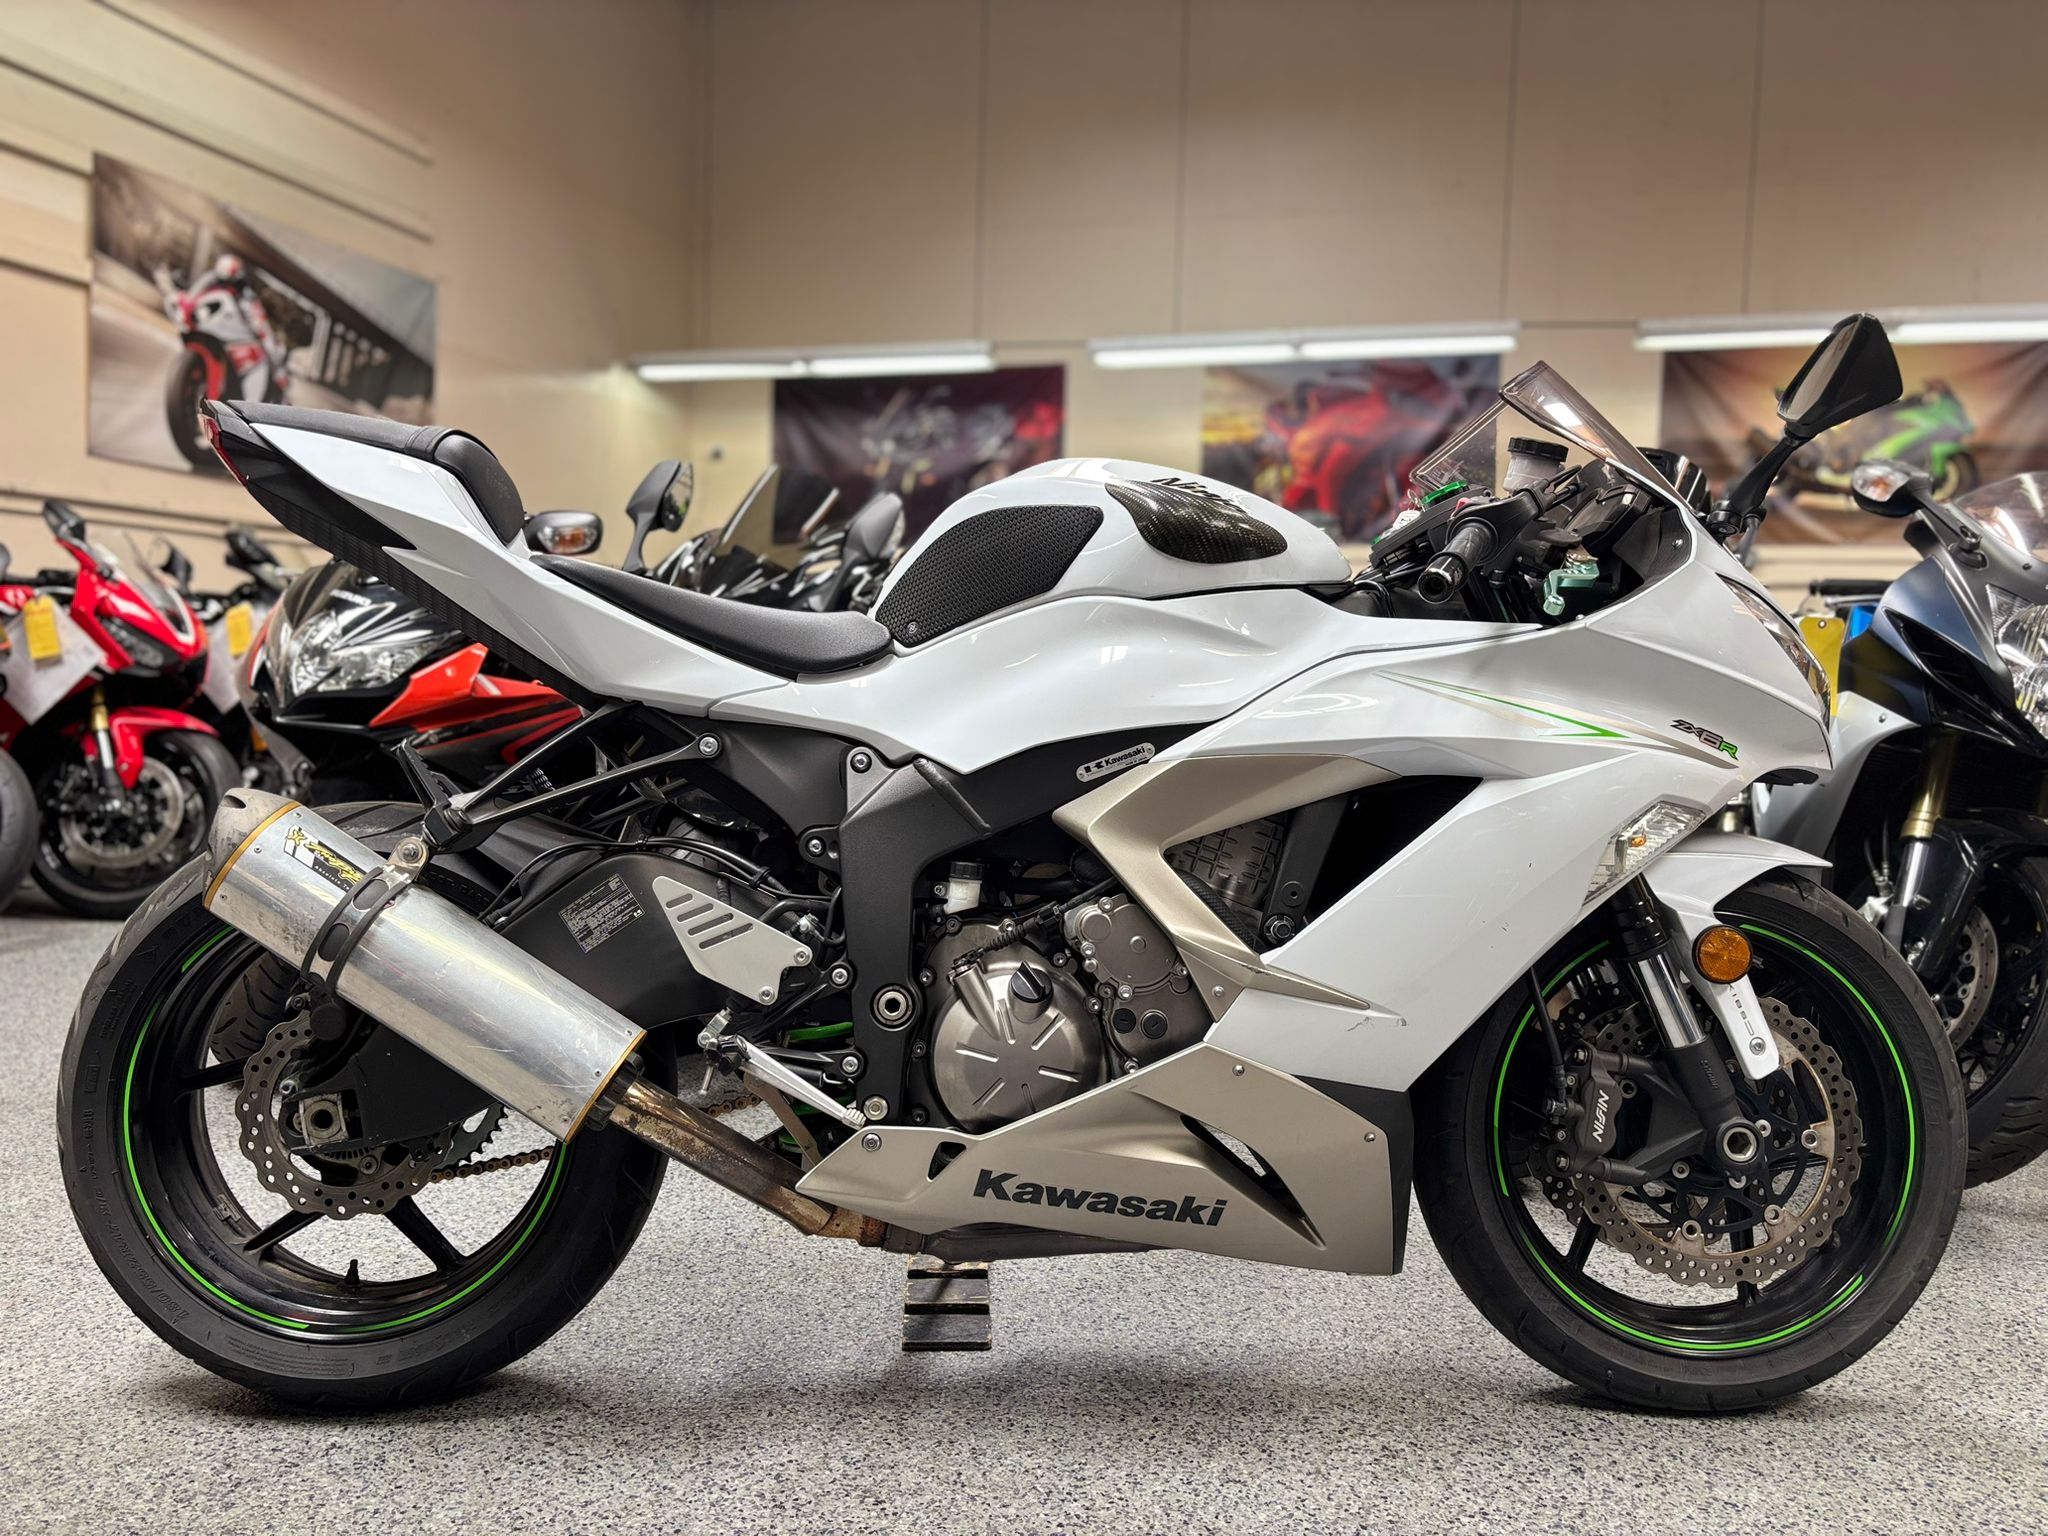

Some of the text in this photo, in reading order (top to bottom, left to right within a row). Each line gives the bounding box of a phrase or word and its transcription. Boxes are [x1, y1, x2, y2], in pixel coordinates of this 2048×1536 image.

[1104, 746, 1146, 767] Kawasaki
[1592, 1089, 1610, 1143] NISSIN
[973, 1168, 1228, 1227] Kawasaki
